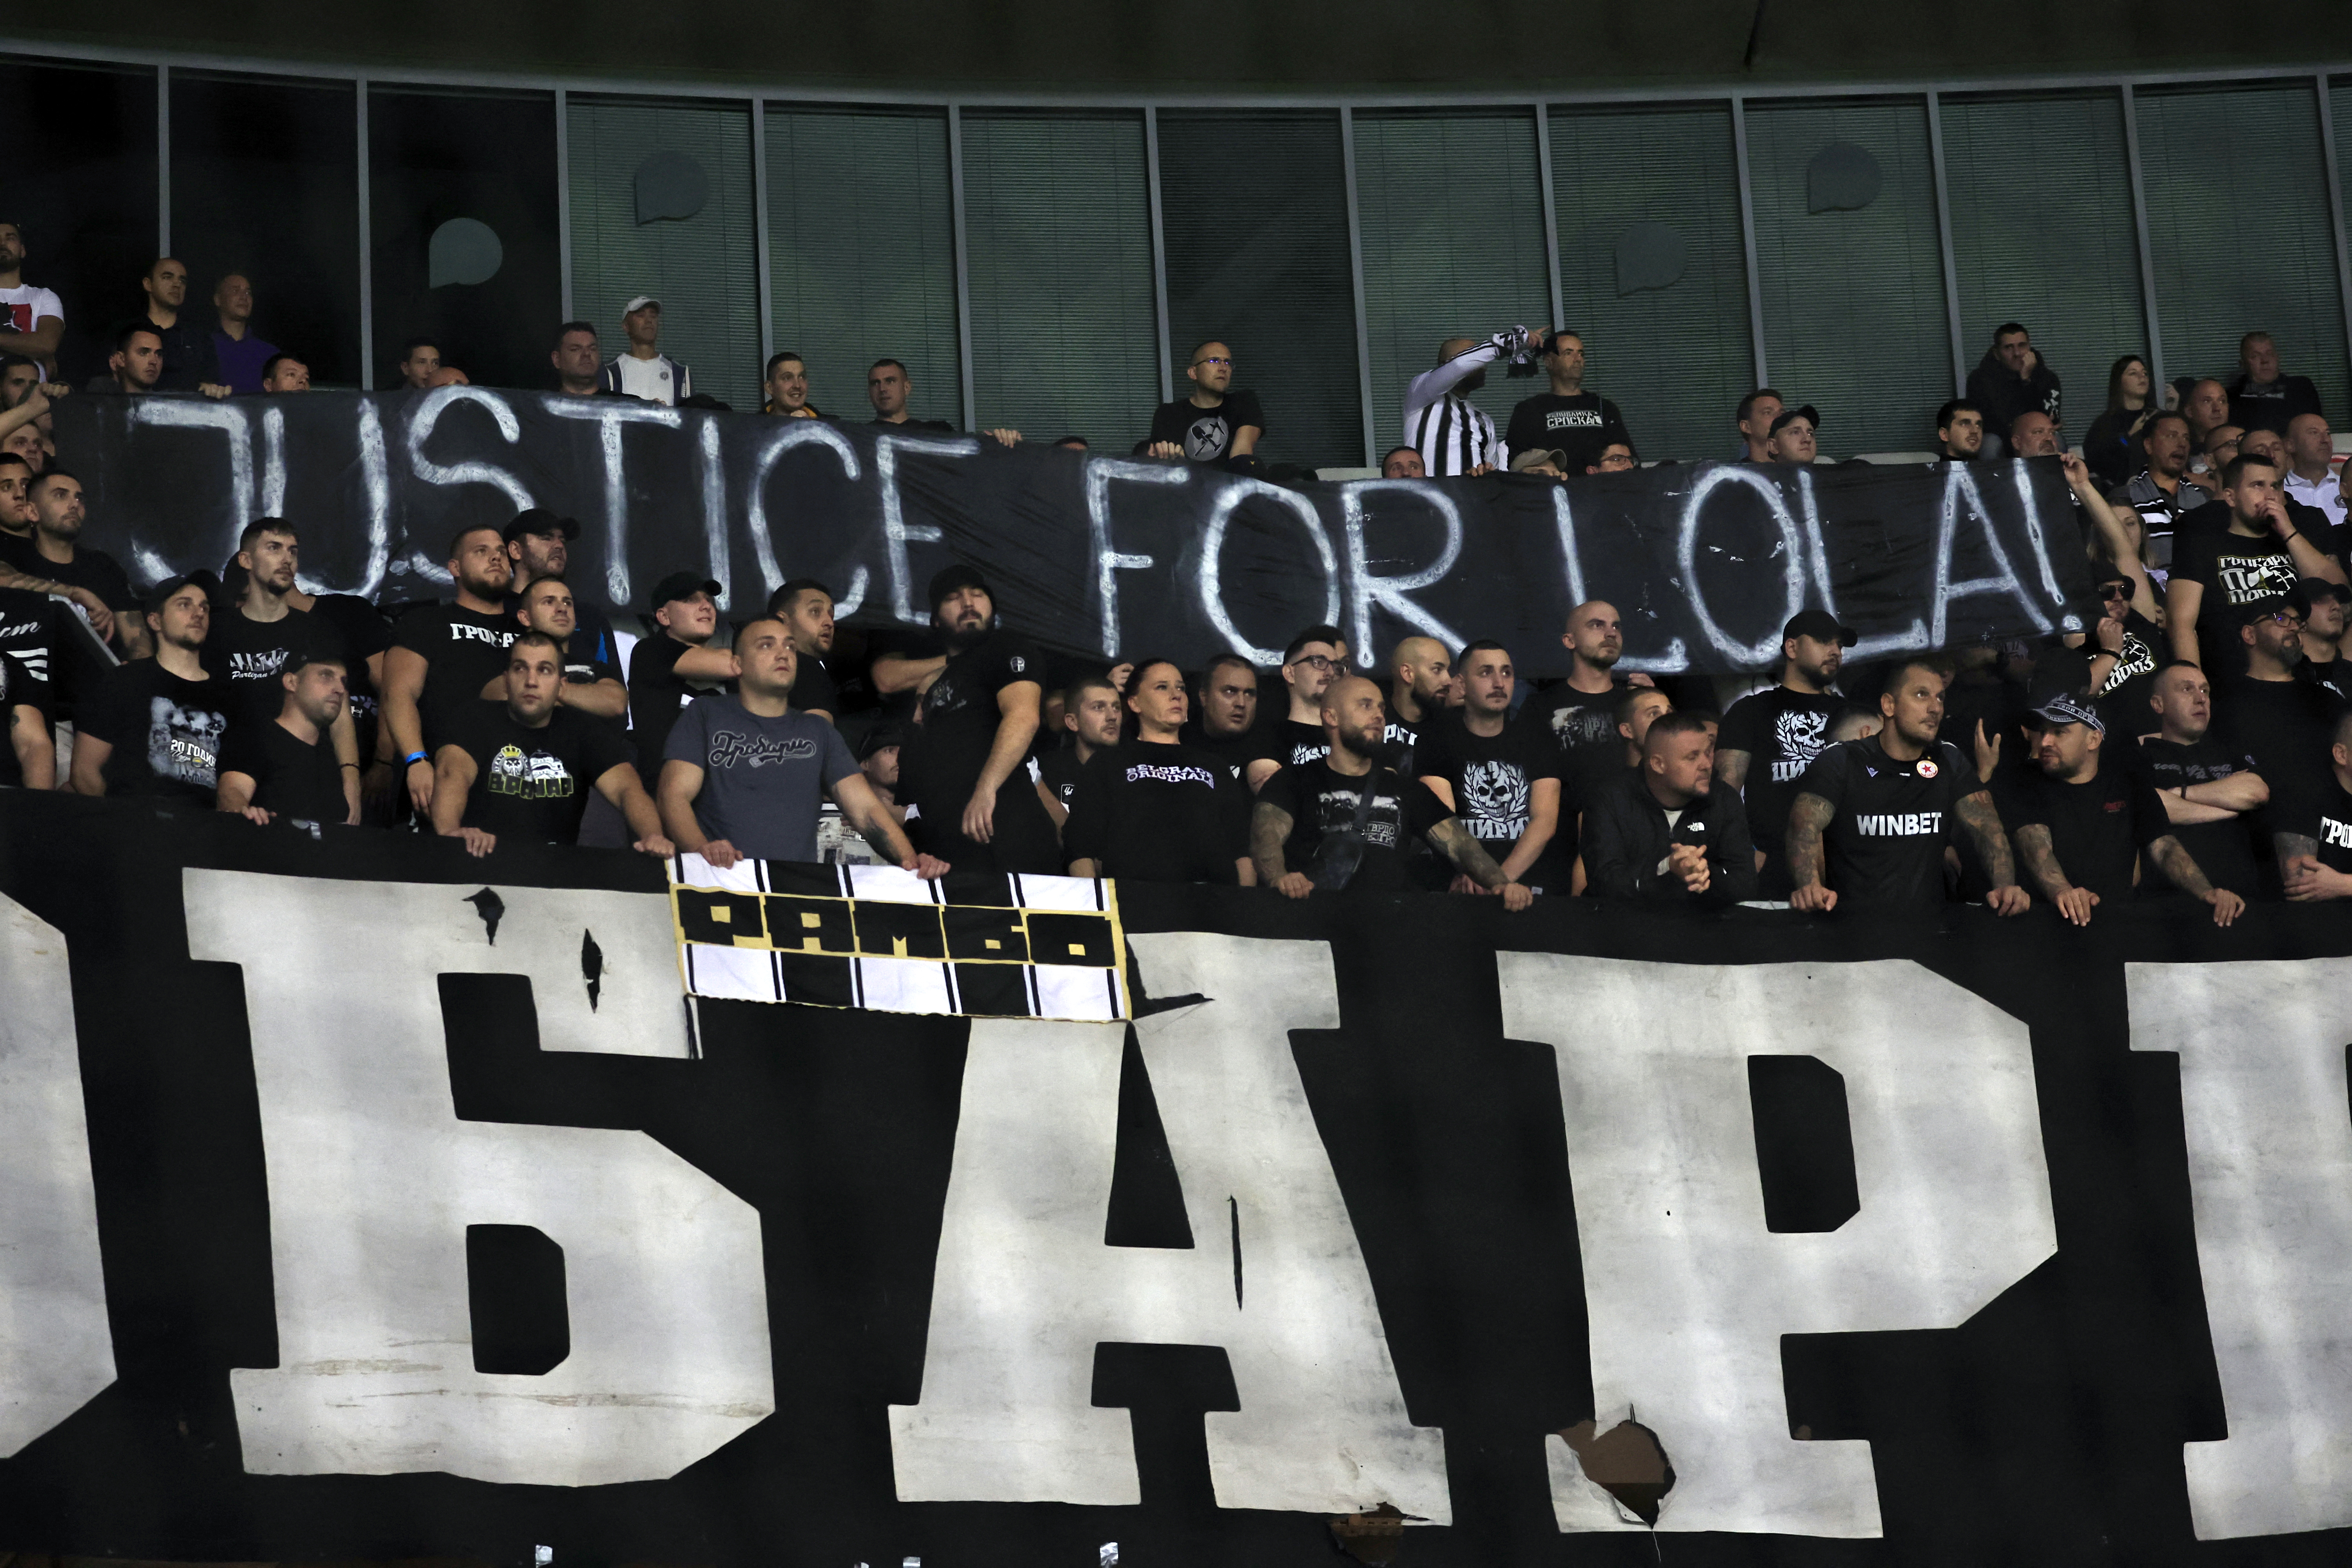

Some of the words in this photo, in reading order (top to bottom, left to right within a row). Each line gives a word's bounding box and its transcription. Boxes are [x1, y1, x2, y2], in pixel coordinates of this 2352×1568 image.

[1547, 416, 1593, 428] СРПСКА
[127, 385, 981, 625] JUSTICE
[1086, 455, 1468, 668] FOR
[1552, 457, 2085, 673] LOLA!
[450, 623, 521, 648] ГРОА
[232, 670, 268, 680] Partizan
[170, 739, 185, 752] 20
[1126, 764, 1213, 779] BELGRADE
[1127, 770, 1214, 789] ORIGINALS
[1771, 759, 1812, 782] ЦИ
[1460, 817, 1530, 839] ИРИ
[1856, 811, 1942, 836] WINBET
[2320, 816, 2352, 849] ГРО
[0, 866, 2352, 1543] БАР
